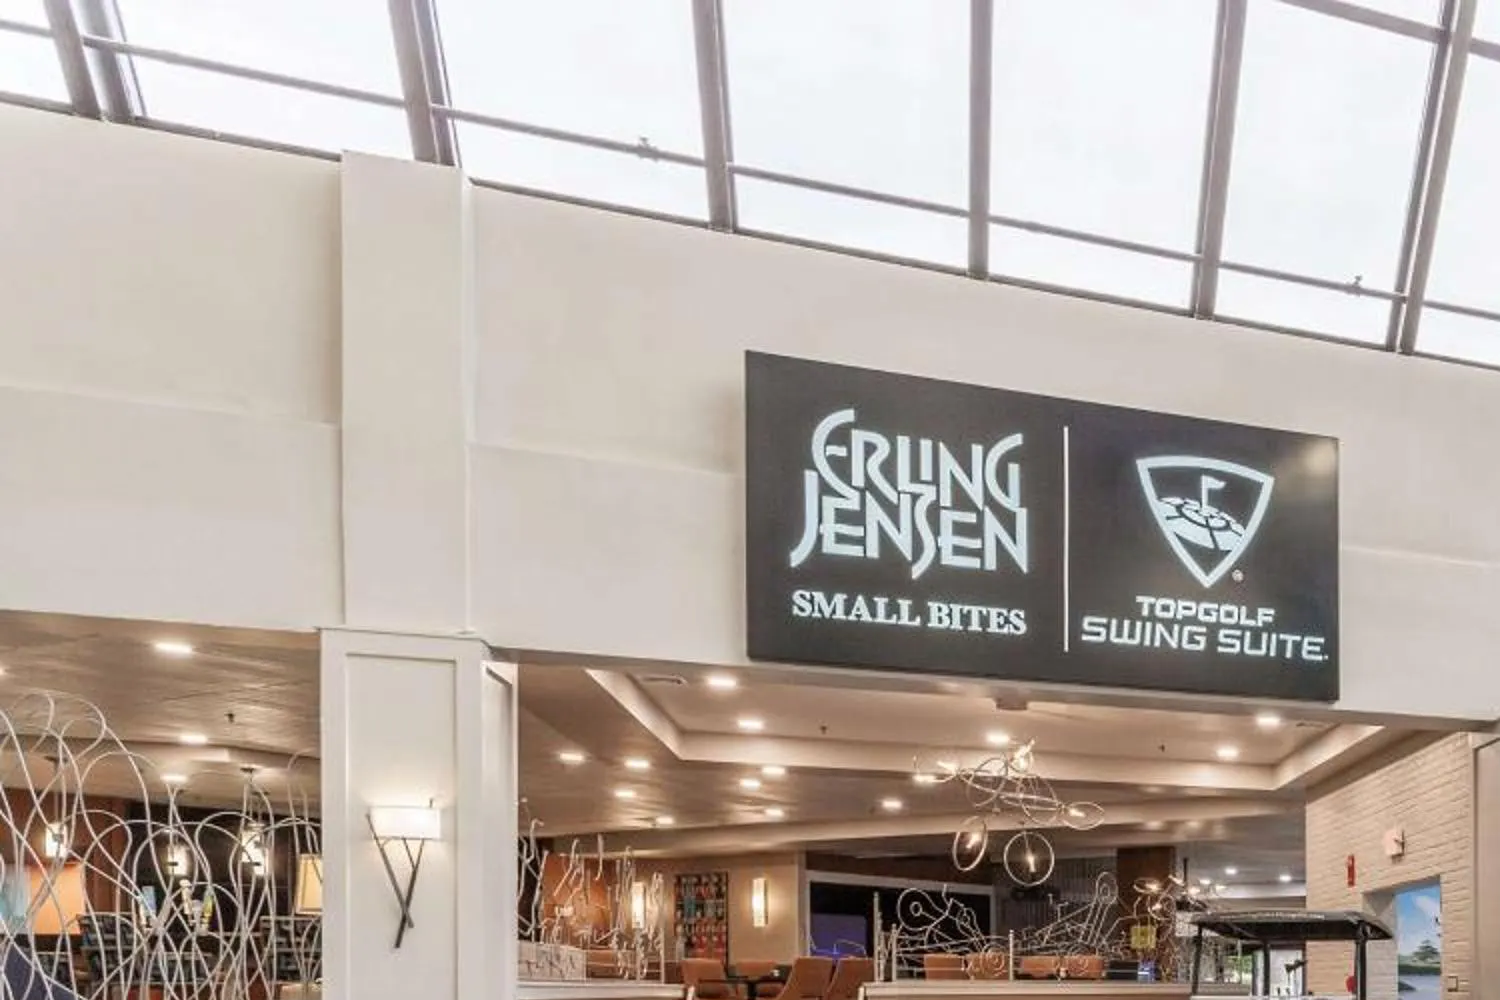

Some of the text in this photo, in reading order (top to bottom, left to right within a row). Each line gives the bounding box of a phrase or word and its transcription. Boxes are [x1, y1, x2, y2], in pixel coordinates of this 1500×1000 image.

[812, 408, 1023, 513] ERLING
[790, 470, 1028, 580] JENSEN
[792, 590, 1028, 636] SMALL BITES
[1081, 616, 1208, 652] SWING
[1135, 595, 1276, 628] TOPGOLF
